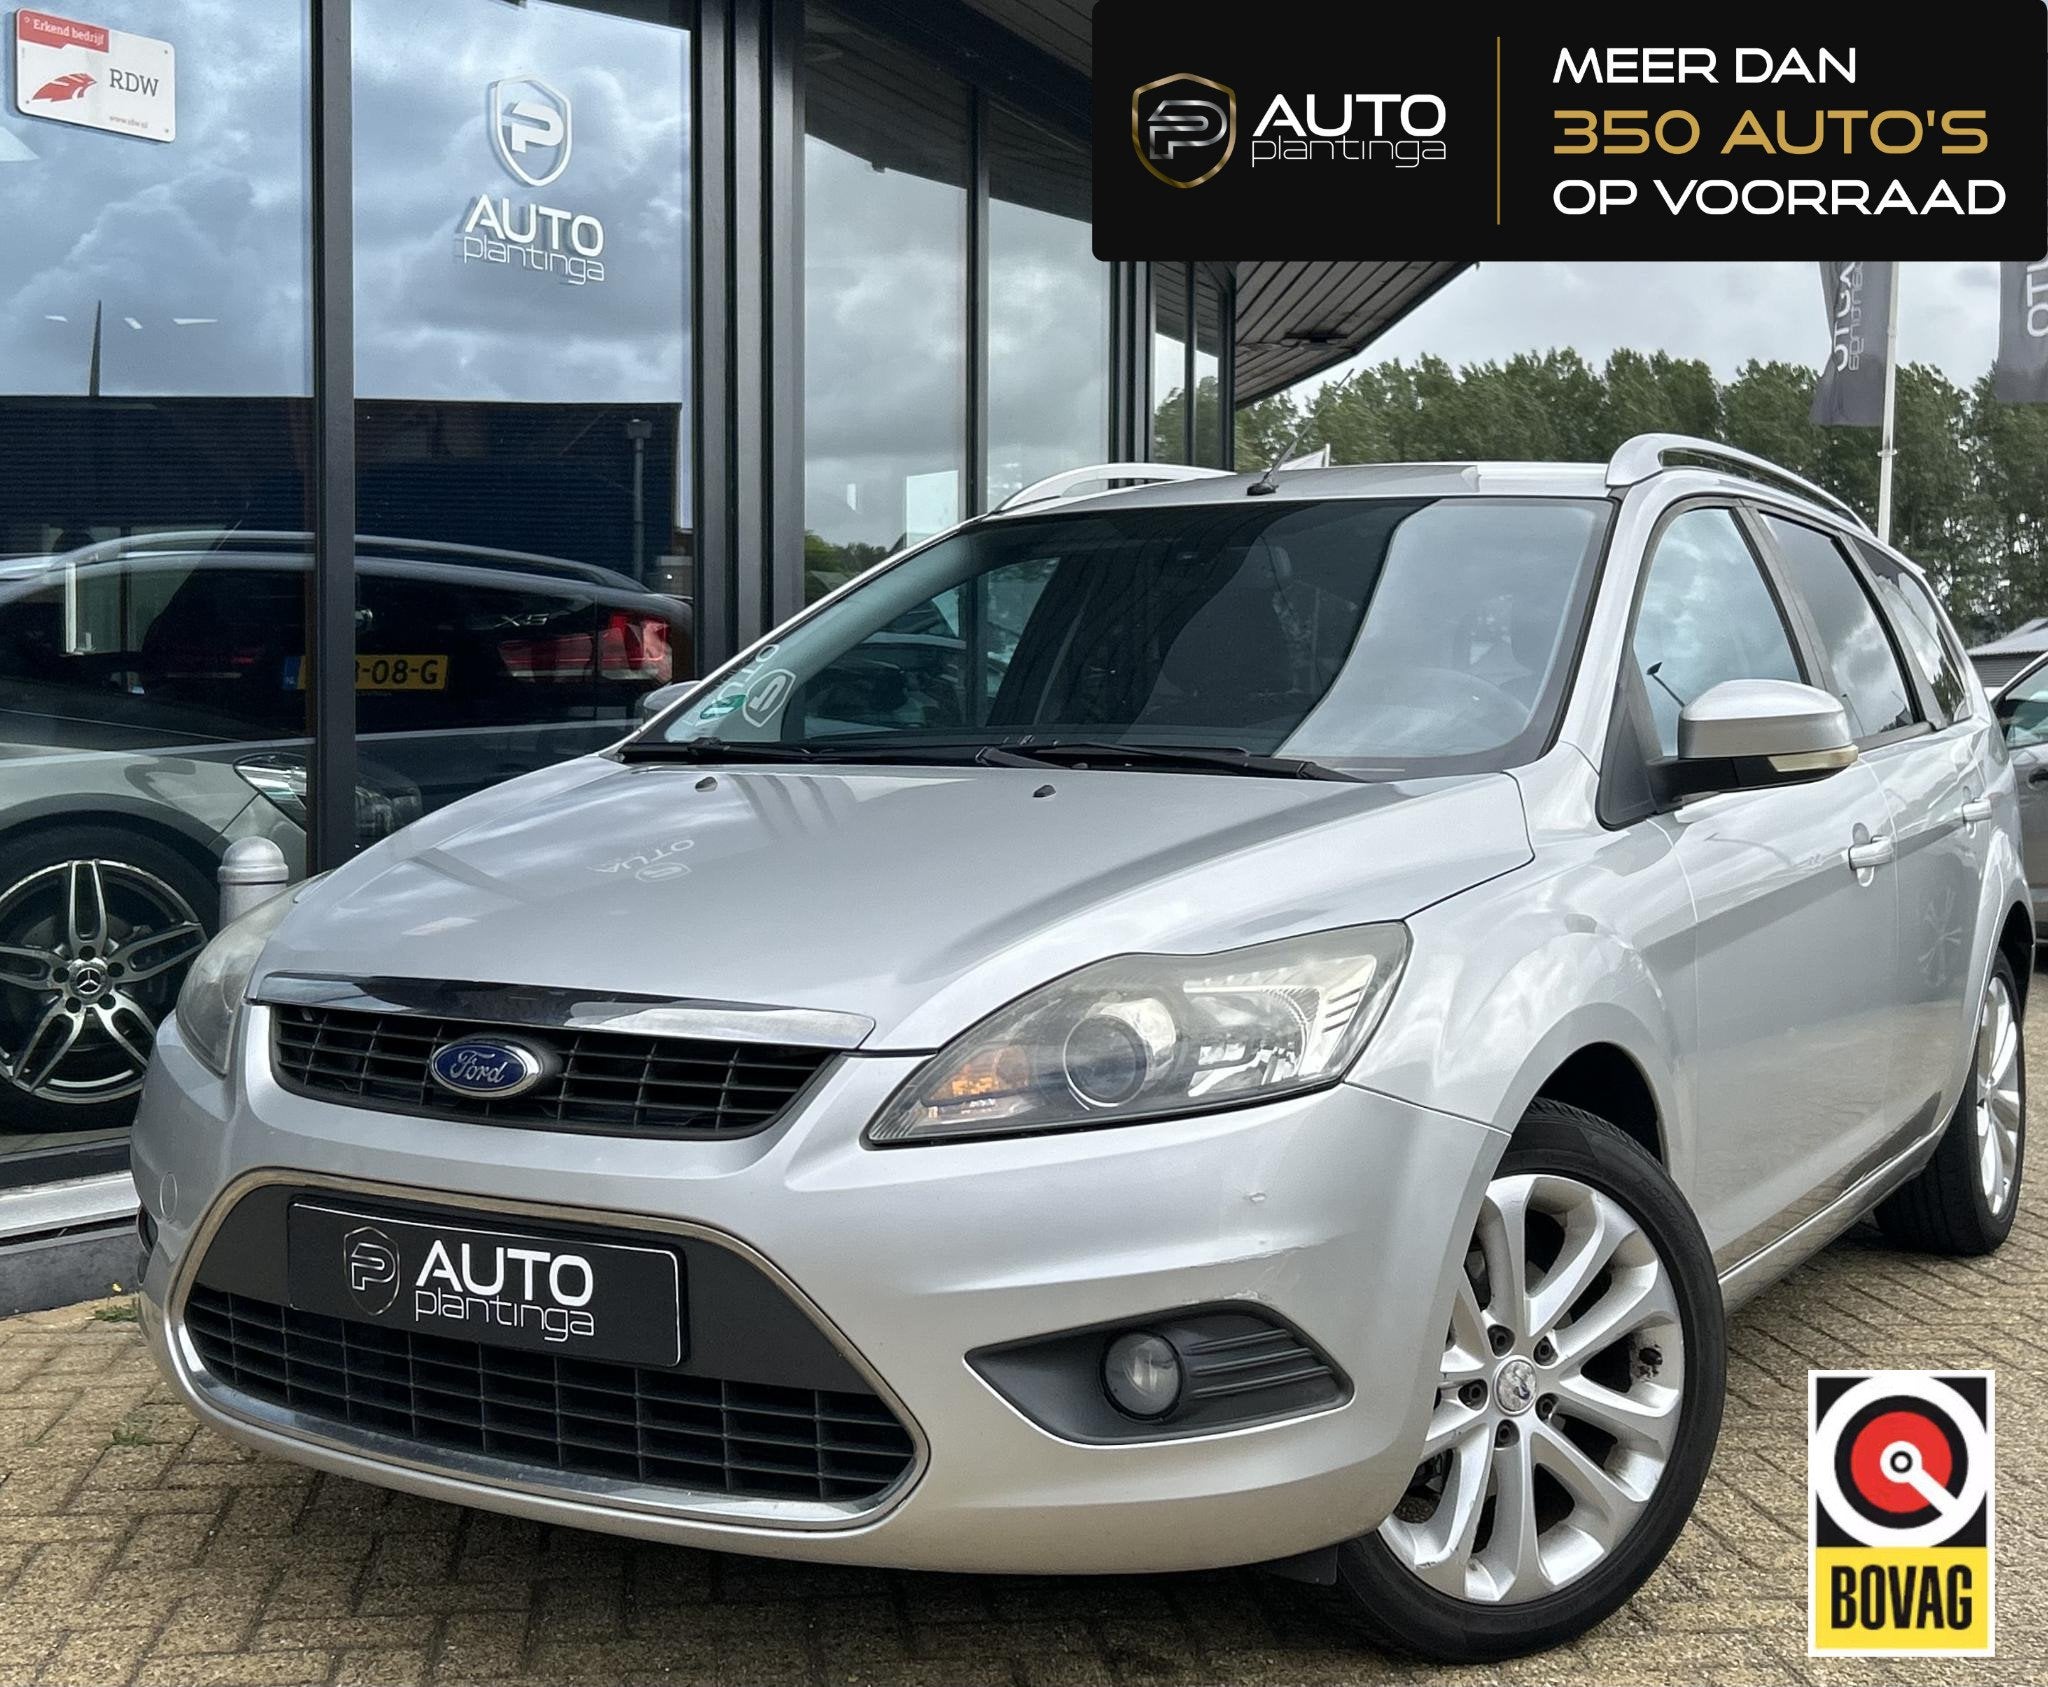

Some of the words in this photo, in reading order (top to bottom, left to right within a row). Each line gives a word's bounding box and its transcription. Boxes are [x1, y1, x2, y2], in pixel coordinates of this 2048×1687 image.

[32, 18, 70, 37] Erkend
[71, 27, 105, 46] bedrijf
[109, 68, 159, 97] RDW
[464, 193, 604, 257] AUTO
[463, 235, 605, 285] plantinga
[450, 1050, 508, 1084] Ford
[415, 1240, 594, 1307] AUTO
[415, 1287, 595, 1343] plantinga
